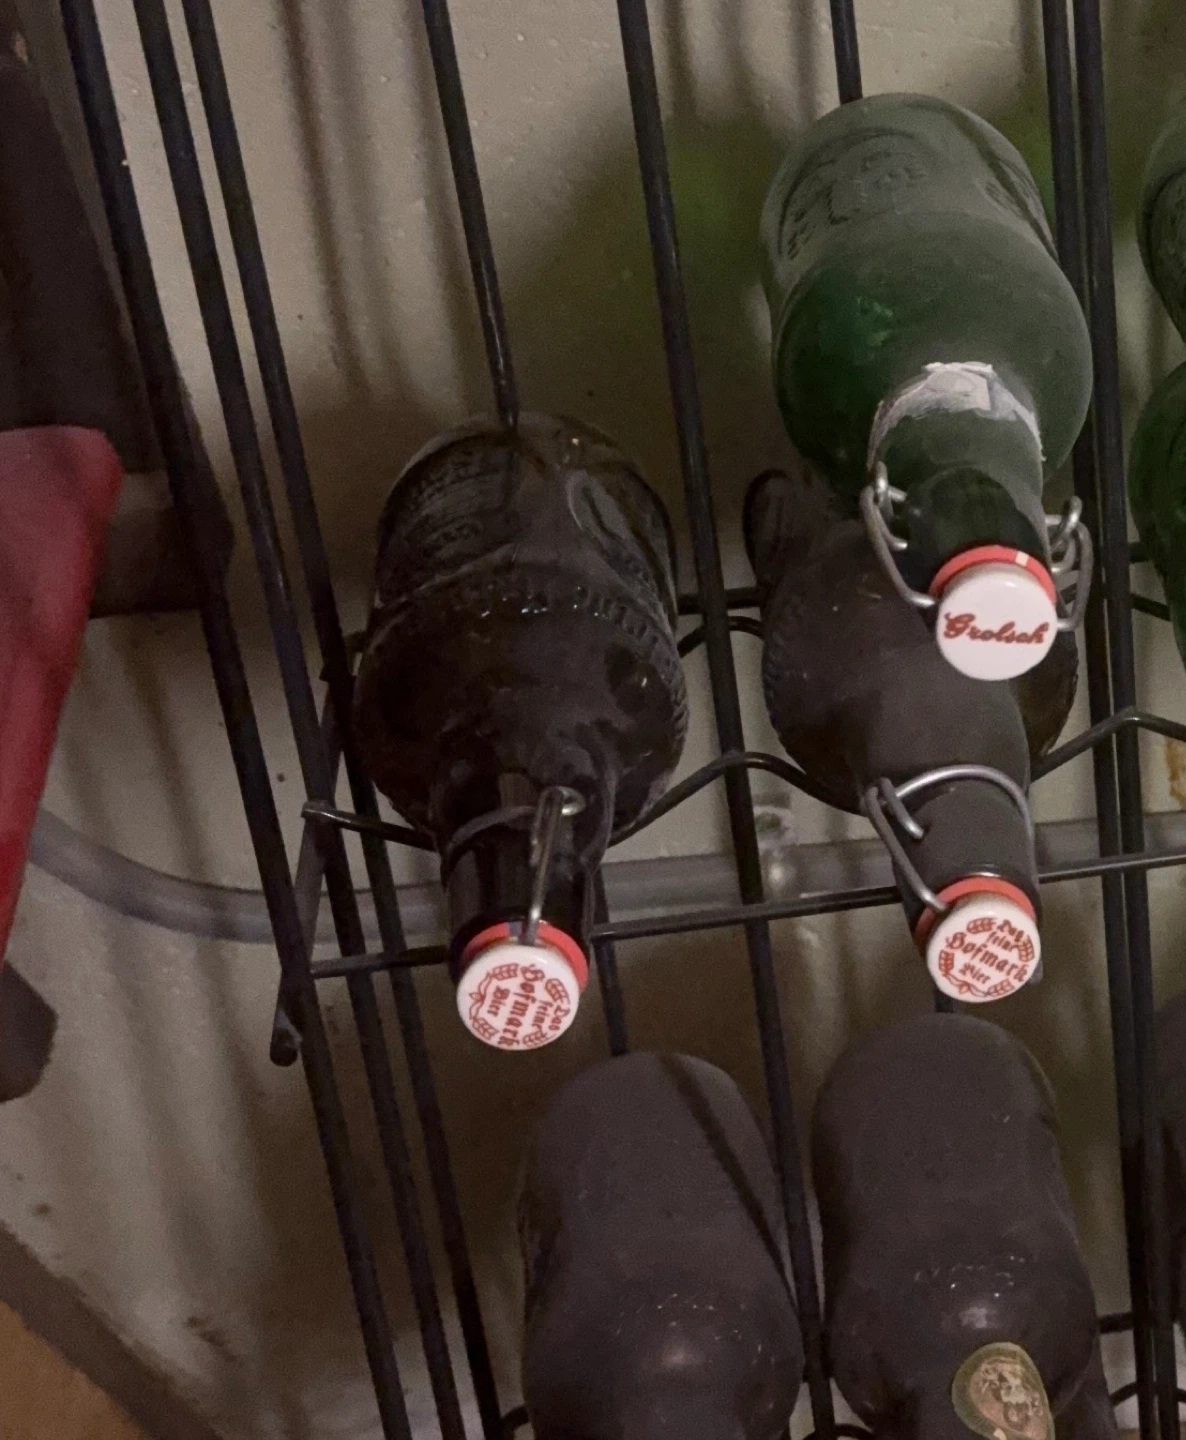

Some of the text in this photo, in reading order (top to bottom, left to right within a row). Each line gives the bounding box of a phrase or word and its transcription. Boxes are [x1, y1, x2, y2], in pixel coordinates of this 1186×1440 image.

[943, 612, 1050, 645] Grolsch
[945, 932, 1029, 982] Hofmark
[487, 986, 510, 1017] Bier
[498, 964, 545, 1046] Hofmark
